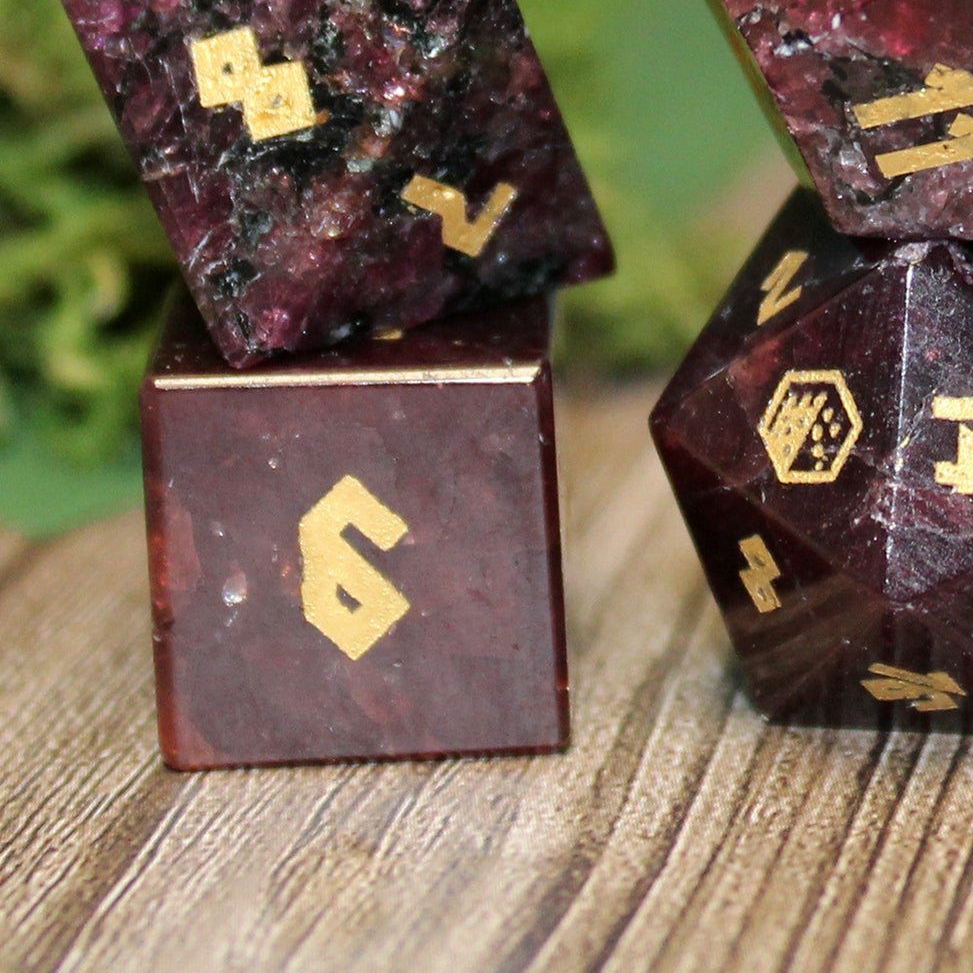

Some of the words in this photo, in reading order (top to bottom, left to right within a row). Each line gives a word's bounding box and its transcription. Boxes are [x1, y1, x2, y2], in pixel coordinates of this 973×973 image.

[190, 26, 316, 141] 8
[298, 474, 411, 661] 6
[739, 535, 781, 613] 8
